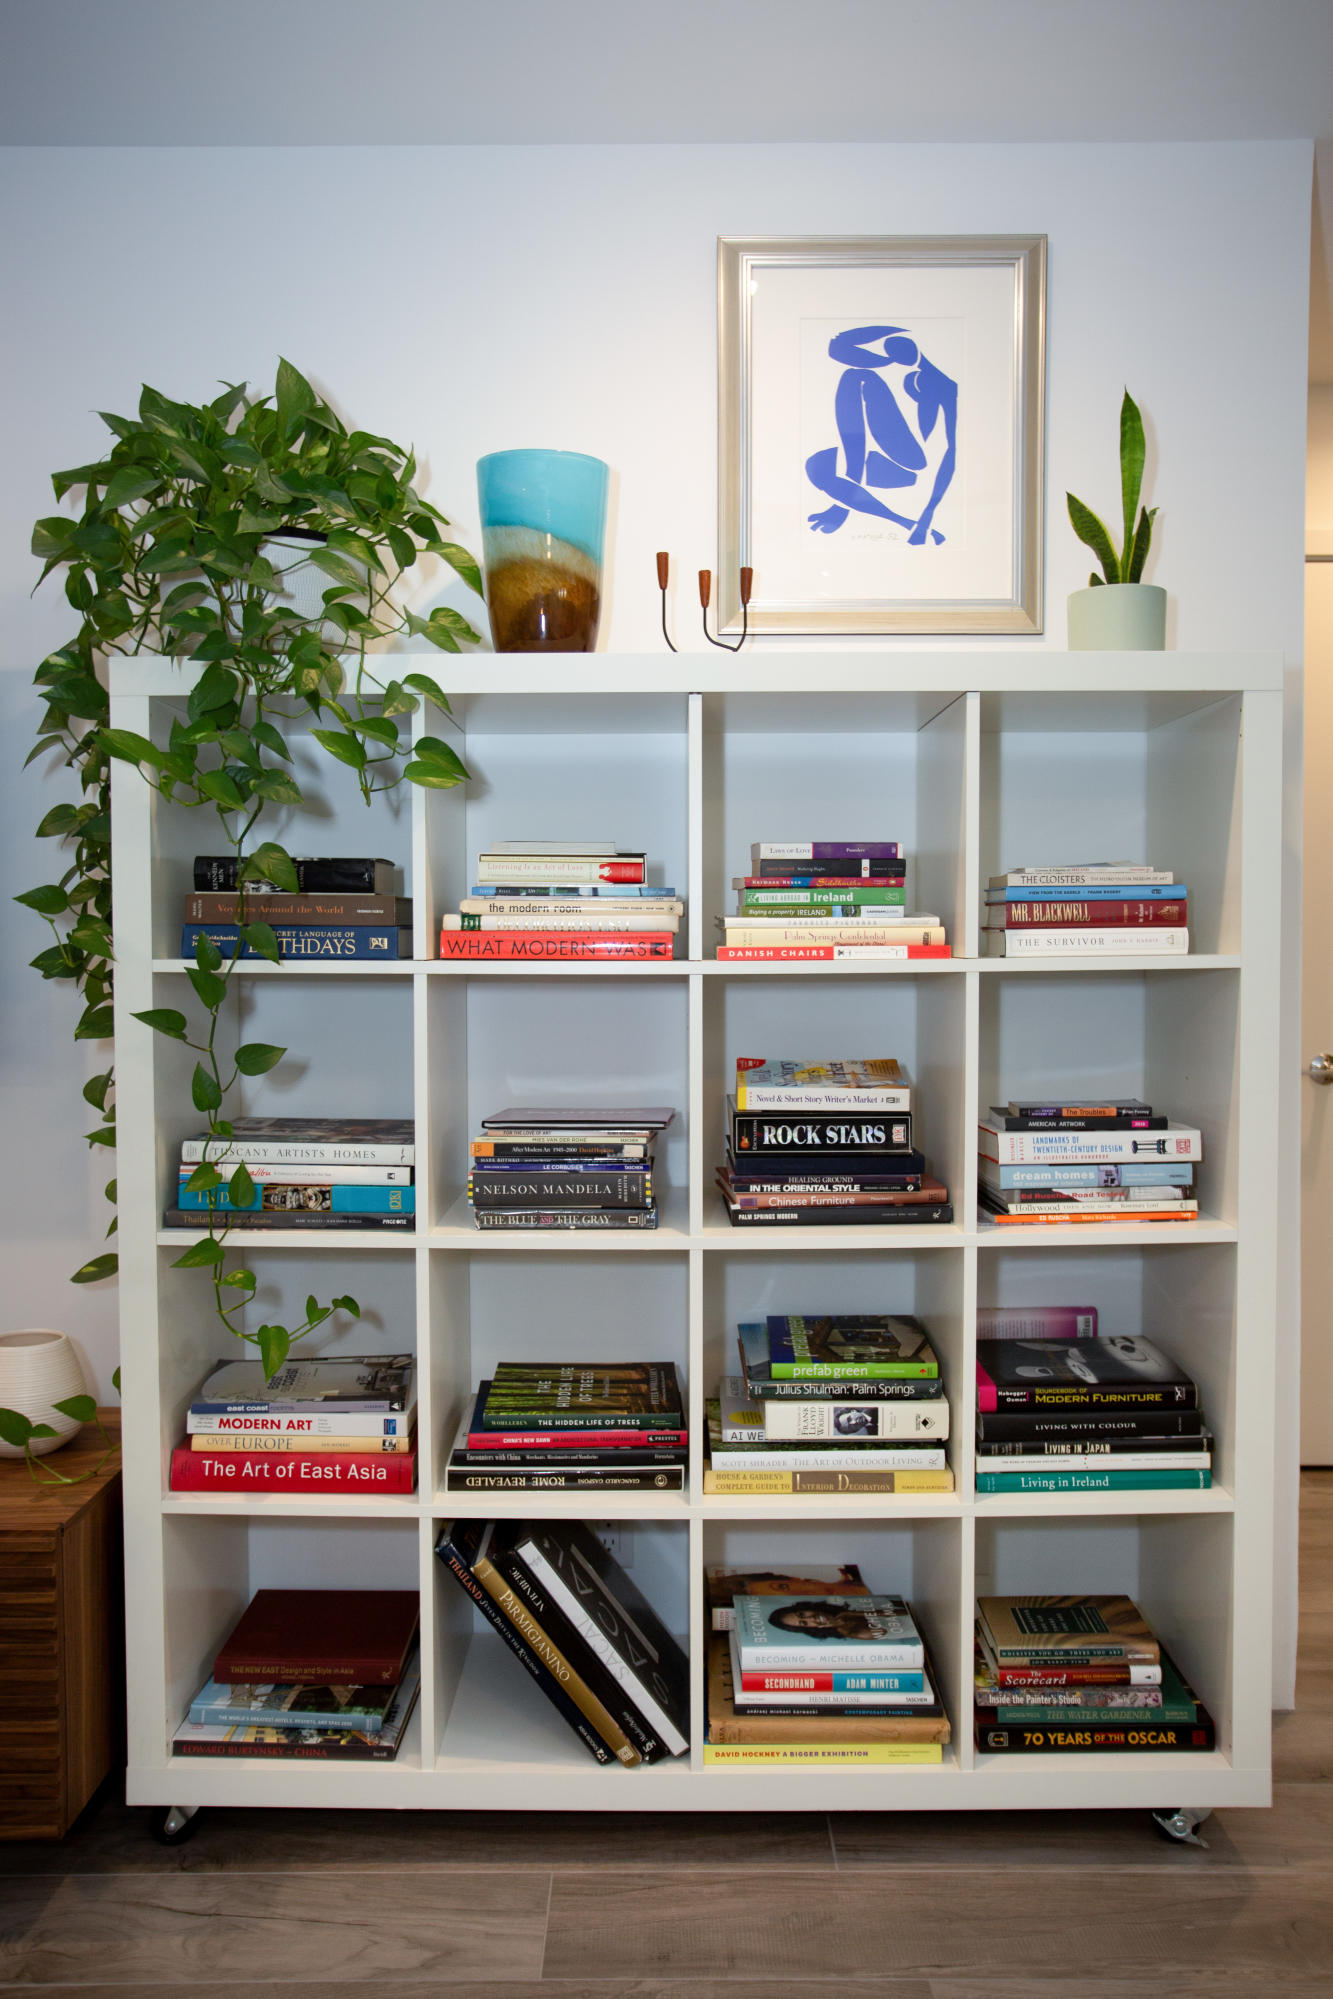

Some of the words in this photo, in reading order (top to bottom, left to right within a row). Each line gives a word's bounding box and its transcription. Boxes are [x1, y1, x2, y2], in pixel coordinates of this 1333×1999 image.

[816, 878, 862, 887] Siddhartha
[489, 902, 504, 913] the
[509, 902, 550, 913] modern
[554, 904, 582, 914] room
[1011, 904, 1032, 923] MR.
[1033, 903, 1091, 922] BLACKWELL
[784, 931, 804, 941] Palm
[808, 931, 837, 943] Springs
[840, 930, 886, 942] Confidential
[447, 940, 504, 955] WHAT
[512, 940, 596, 956] MODERN
[601, 942, 646, 956] WAS
[756, 1094, 776, 1104] Novel
[777, 1096, 783, 1104] &
[784, 1095, 802, 1104] Short
[804, 1095, 822, 1105] Story
[824, 1095, 852, 1104] Writer's
[852, 1096, 878, 1104] Market
[764, 1124, 821, 1145] ROCK
[826, 1124, 885, 1145] STARS
[1032, 1137, 1070, 1145] LANDMARKS
[1033, 1146, 1098, 1154] TWENTIETH-CENTURY
[1013, 1170, 1052, 1181] dream
[1055, 1170, 1095, 1180] homes
[483, 1185, 537, 1196] NELSON
[544, 1184, 612, 1194] MANDELA
[768, 1196, 808, 1206] Chinese
[810, 1196, 856, 1206] Furniture
[480, 1214, 506, 1224] THE
[508, 1214, 537, 1224] BLUE
[540, 1215, 554, 1224] AND
[556, 1214, 578, 1224] THE
[582, 1214, 610, 1225] GRAY
[560, 1367, 574, 1381] LIFE
[794, 1364, 830, 1378] prefab
[834, 1367, 868, 1378] green
[537, 1380, 552, 1394] THE
[580, 1371, 594, 1391] TREES
[556, 1383, 572, 1408] HIDDEN
[775, 1384, 801, 1395] Julius
[803, 1383, 850, 1395] Shulman:
[852, 1383, 876, 1394] Palm
[878, 1383, 915, 1397] Springs
[578, 1394, 593, 1402] OF
[1036, 1396, 1090, 1405] MODERN
[1092, 1394, 1162, 1404] FURNITURE
[218, 1418, 282, 1430] MODERN
[286, 1419, 312, 1430] ART
[206, 1438, 233, 1446] OVER
[234, 1438, 293, 1450] EUROPE
[1045, 1442, 1070, 1454] LIVING
[1074, 1444, 1082, 1454] IN
[1085, 1441, 1111, 1454] JAPAN
[793, 1458, 811, 1466] THE
[814, 1458, 832, 1466] ART
[834, 1458, 844, 1466] OF
[845, 1458, 890, 1466] OUTDOOR
[892, 1456, 922, 1465] LIVING
[202, 1460, 236, 1476] The
[242, 1460, 270, 1478] Art
[276, 1462, 295, 1478] of
[300, 1462, 342, 1480] East
[347, 1464, 387, 1480] Asia
[466, 1476, 526, 1487] REVEALED
[532, 1476, 565, 1486] ROME
[796, 1473, 834, 1491] INTERIOR
[838, 1474, 890, 1492] DECORATION
[1021, 1477, 1056, 1490] Living
[1059, 1476, 1068, 1488] in
[1072, 1476, 1109, 1488] Ireland
[746, 1596, 768, 1644] BECOMING
[862, 1596, 884, 1640] MICHELLE
[883, 1602, 905, 1635] OBAMA
[499, 1590, 570, 1682] PARMIGIANINO
[578, 1617, 630, 1681] SACAL
[756, 1655, 806, 1664] BECOMING
[820, 1654, 865, 1663] MICHELLE
[870, 1654, 904, 1663] OBAMA
[280, 1666, 302, 1676] Design
[316, 1666, 332, 1676] Style
[764, 1678, 815, 1689] SECONDHAND
[846, 1679, 867, 1689] ADAM
[870, 1679, 900, 1689] MINTER
[1005, 1674, 1067, 1686] Scorecard
[989, 1694, 1010, 1704] Inside
[1012, 1694, 1024, 1704] the
[1026, 1694, 1058, 1704] Painter's
[1058, 1694, 1081, 1704] Studio
[1046, 1710, 1064, 1718] THE
[1068, 1710, 1098, 1719] WATER
[1100, 1710, 1152, 1719] GARDENER
[1024, 1733, 1044, 1745] 70
[1047, 1732, 1092, 1745] YEARS
[1128, 1732, 1176, 1744] OSCAR
[183, 1744, 224, 1754] EDWARD
[228, 1746, 285, 1755] BURTYNSKY
[294, 1748, 327, 1757] CHINA
